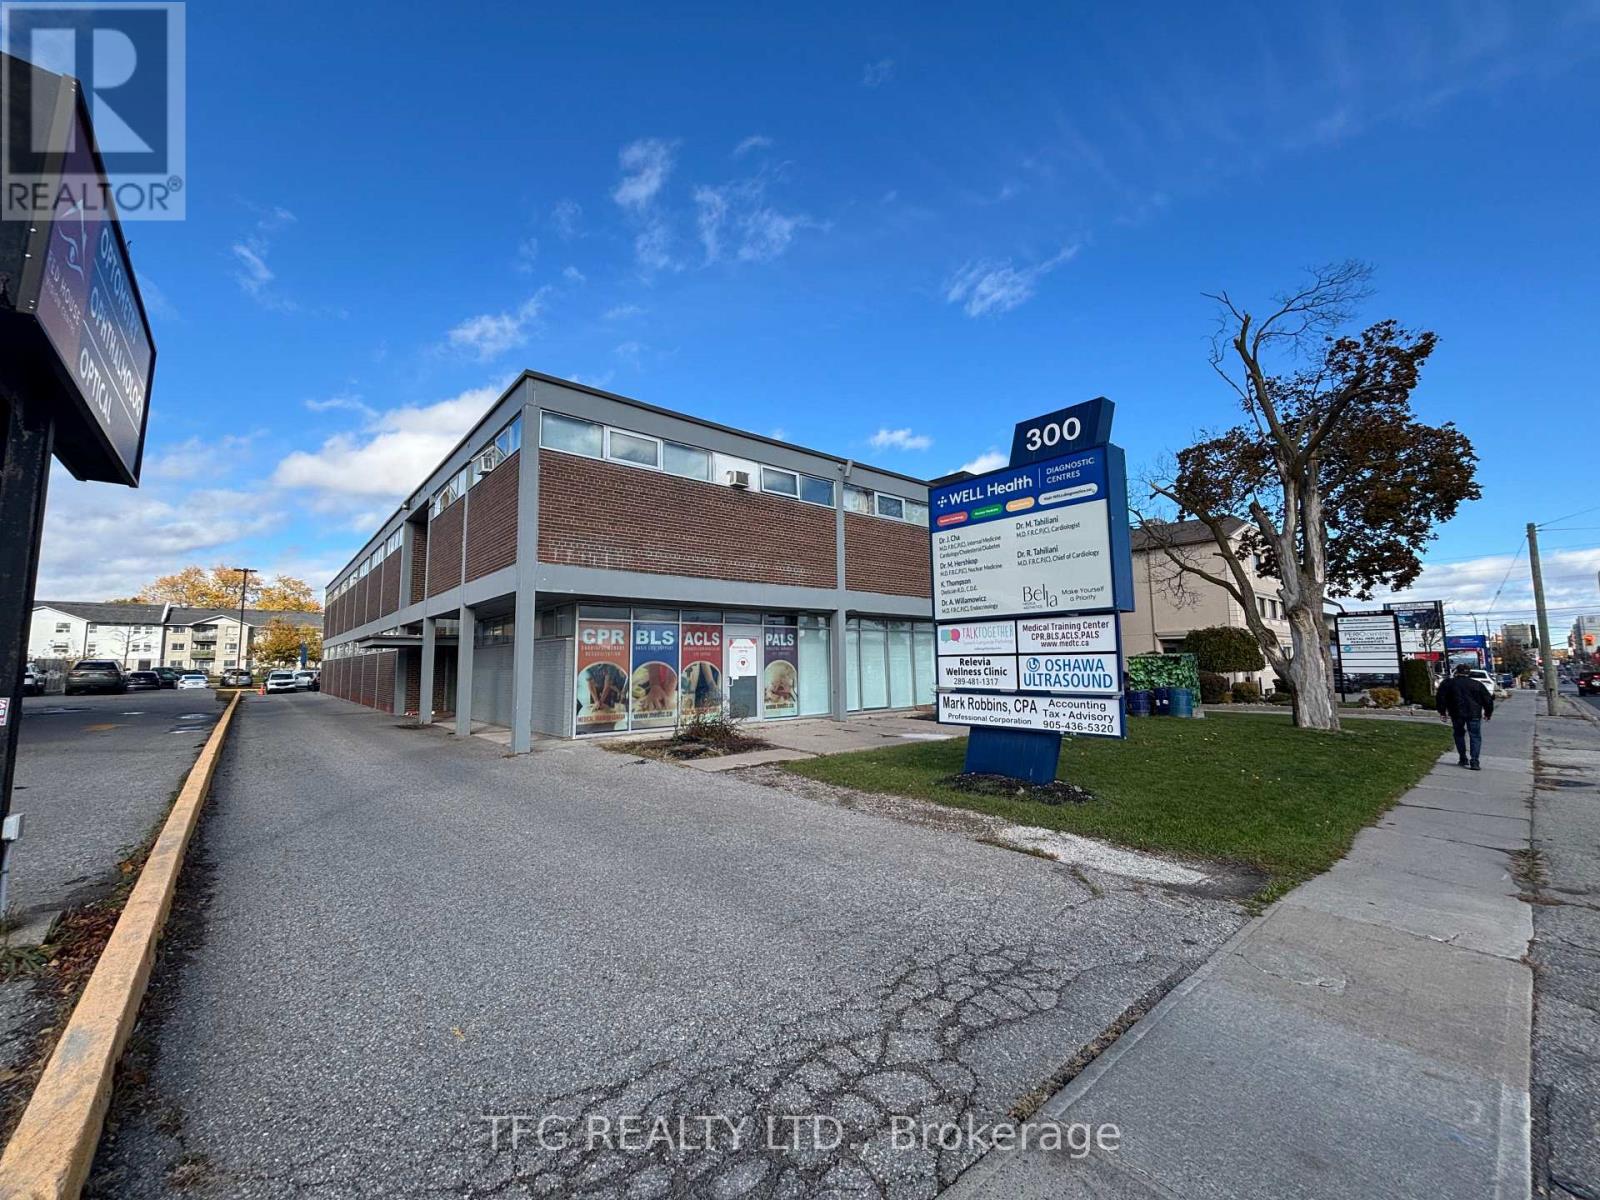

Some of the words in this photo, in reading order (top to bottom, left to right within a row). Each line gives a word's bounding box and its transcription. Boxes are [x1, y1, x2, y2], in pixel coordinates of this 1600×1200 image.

[100, 227, 139, 344] OPTOMETRY
[80, 347, 111, 424] OPTICAL
[1026, 417, 1081, 451] 300
[1046, 457, 1095, 475] DIAGNOSTIC
[1046, 470, 1080, 484] CENTRES
[949, 487, 984, 505] WELL
[987, 475, 1032, 495] Health
[1026, 520, 1032, 528] M.
[1051, 522, 1081, 532] Cardiologist
[1016, 550, 1025, 558] Dr.
[1023, 584, 1058, 608] Bella
[1061, 587, 1078, 595] Make
[1080, 585, 1104, 594] Yourself
[1022, 623, 1050, 632] Medical
[1051, 622, 1081, 631] Training
[1083, 621, 1109, 629] Center
[582, 628, 625, 645] CPR
[635, 629, 674, 645] BLS
[684, 631, 720, 646] ACLS
[765, 633, 794, 646] PALS
[1041, 640, 1089, 648] www.medtc.ca
[959, 657, 991, 666] Relevia
[1044, 658, 1105, 672] OSHAWA
[946, 667, 982, 676] Wellness
[984, 667, 1008, 676] Clinic
[953, 677, 998, 686] 289-481-1317
[1023, 673, 1113, 688] ULTRASOUND
[943, 696, 965, 709] Mark
[967, 697, 1011, 714] Robbins,
[1014, 698, 1038, 714] CPA
[1048, 699, 1107, 712] Accounting
[948, 713, 988, 722] Professional
[989, 715, 1032, 725] Corporation
[1043, 709, 1060, 718] Tax
[1068, 711, 1114, 724] Advisory
[1043, 720, 1114, 733] 905-436-5320
